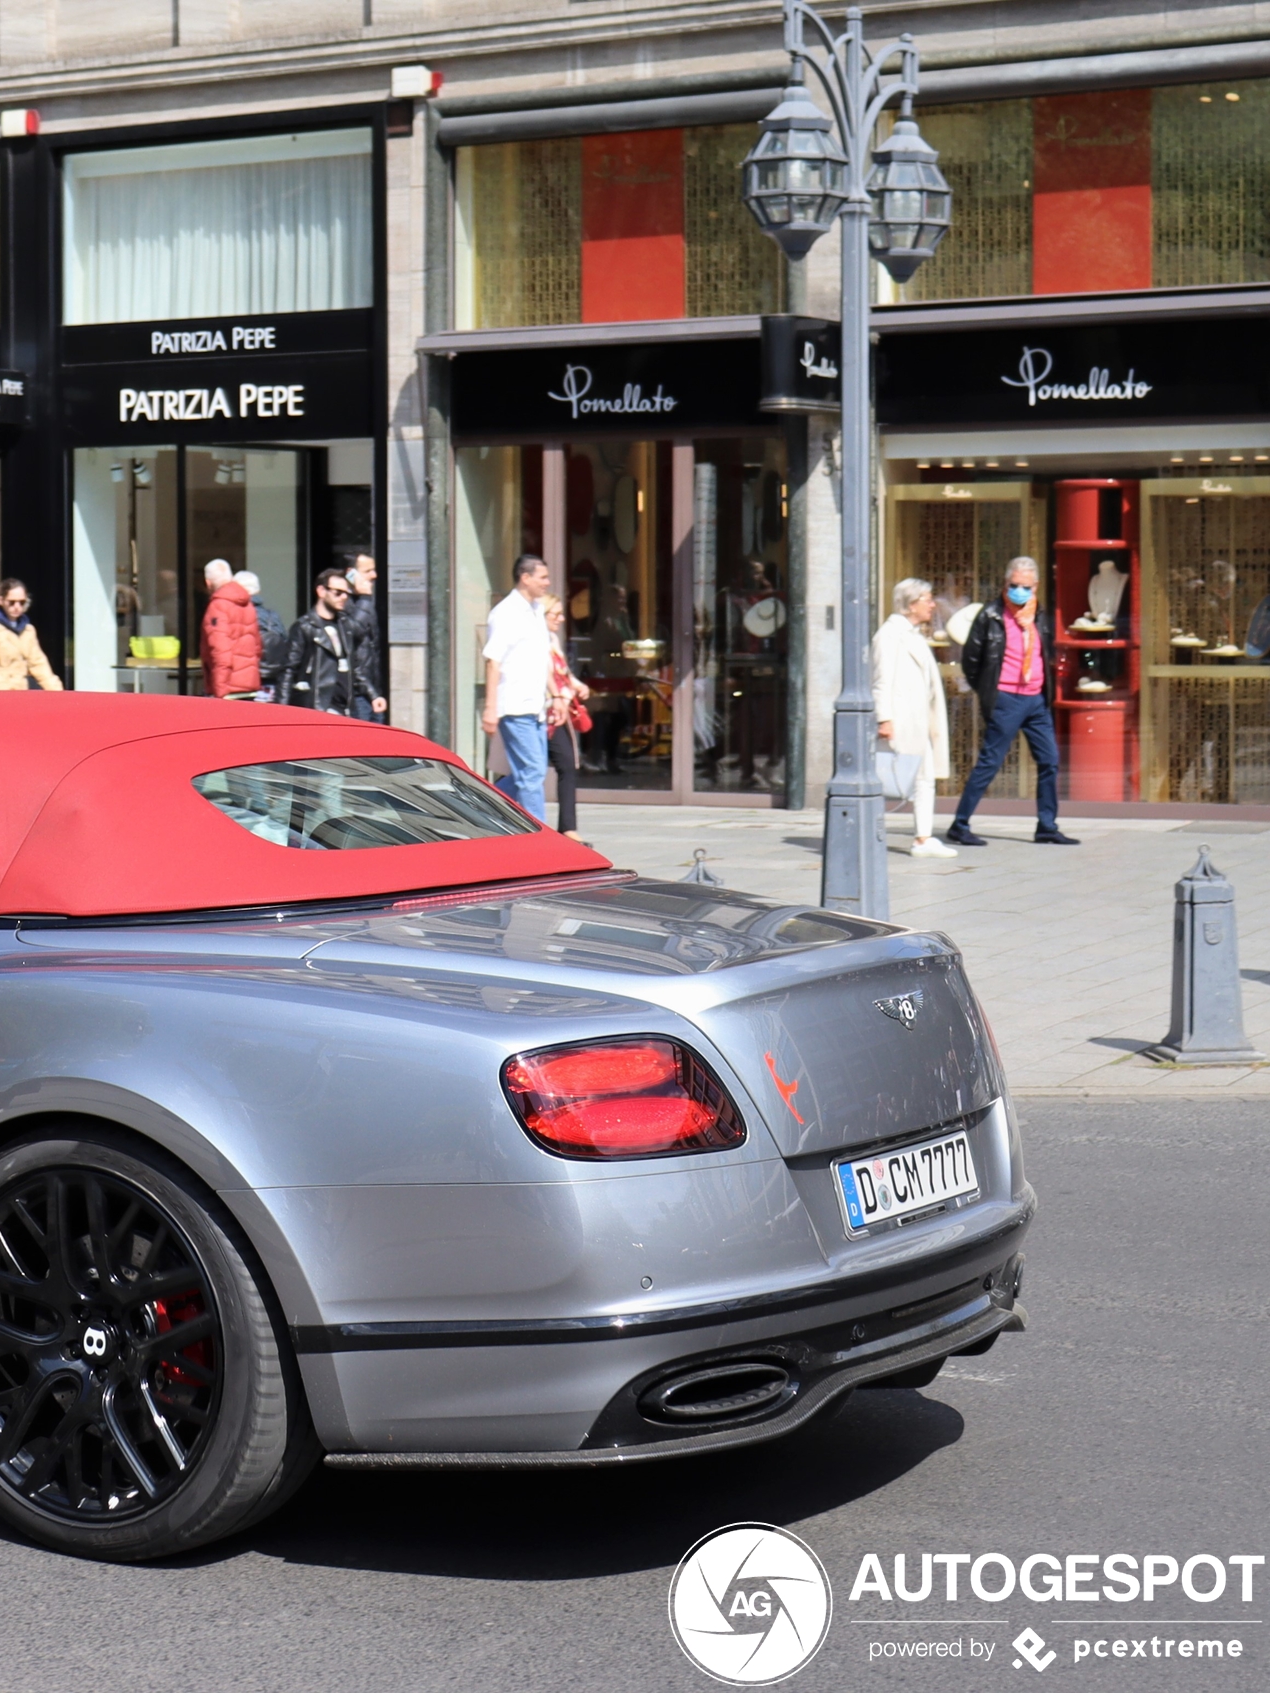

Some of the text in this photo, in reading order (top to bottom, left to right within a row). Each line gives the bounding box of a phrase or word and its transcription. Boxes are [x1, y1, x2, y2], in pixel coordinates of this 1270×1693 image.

[151, 326, 276, 354] PATRIZIA PEPE
[547, 364, 678, 419] Pomellato
[1000, 346, 1153, 406] Pomellato
[119, 383, 305, 422] PATRIZIA PEPE
[856, 1166, 878, 1214] D
